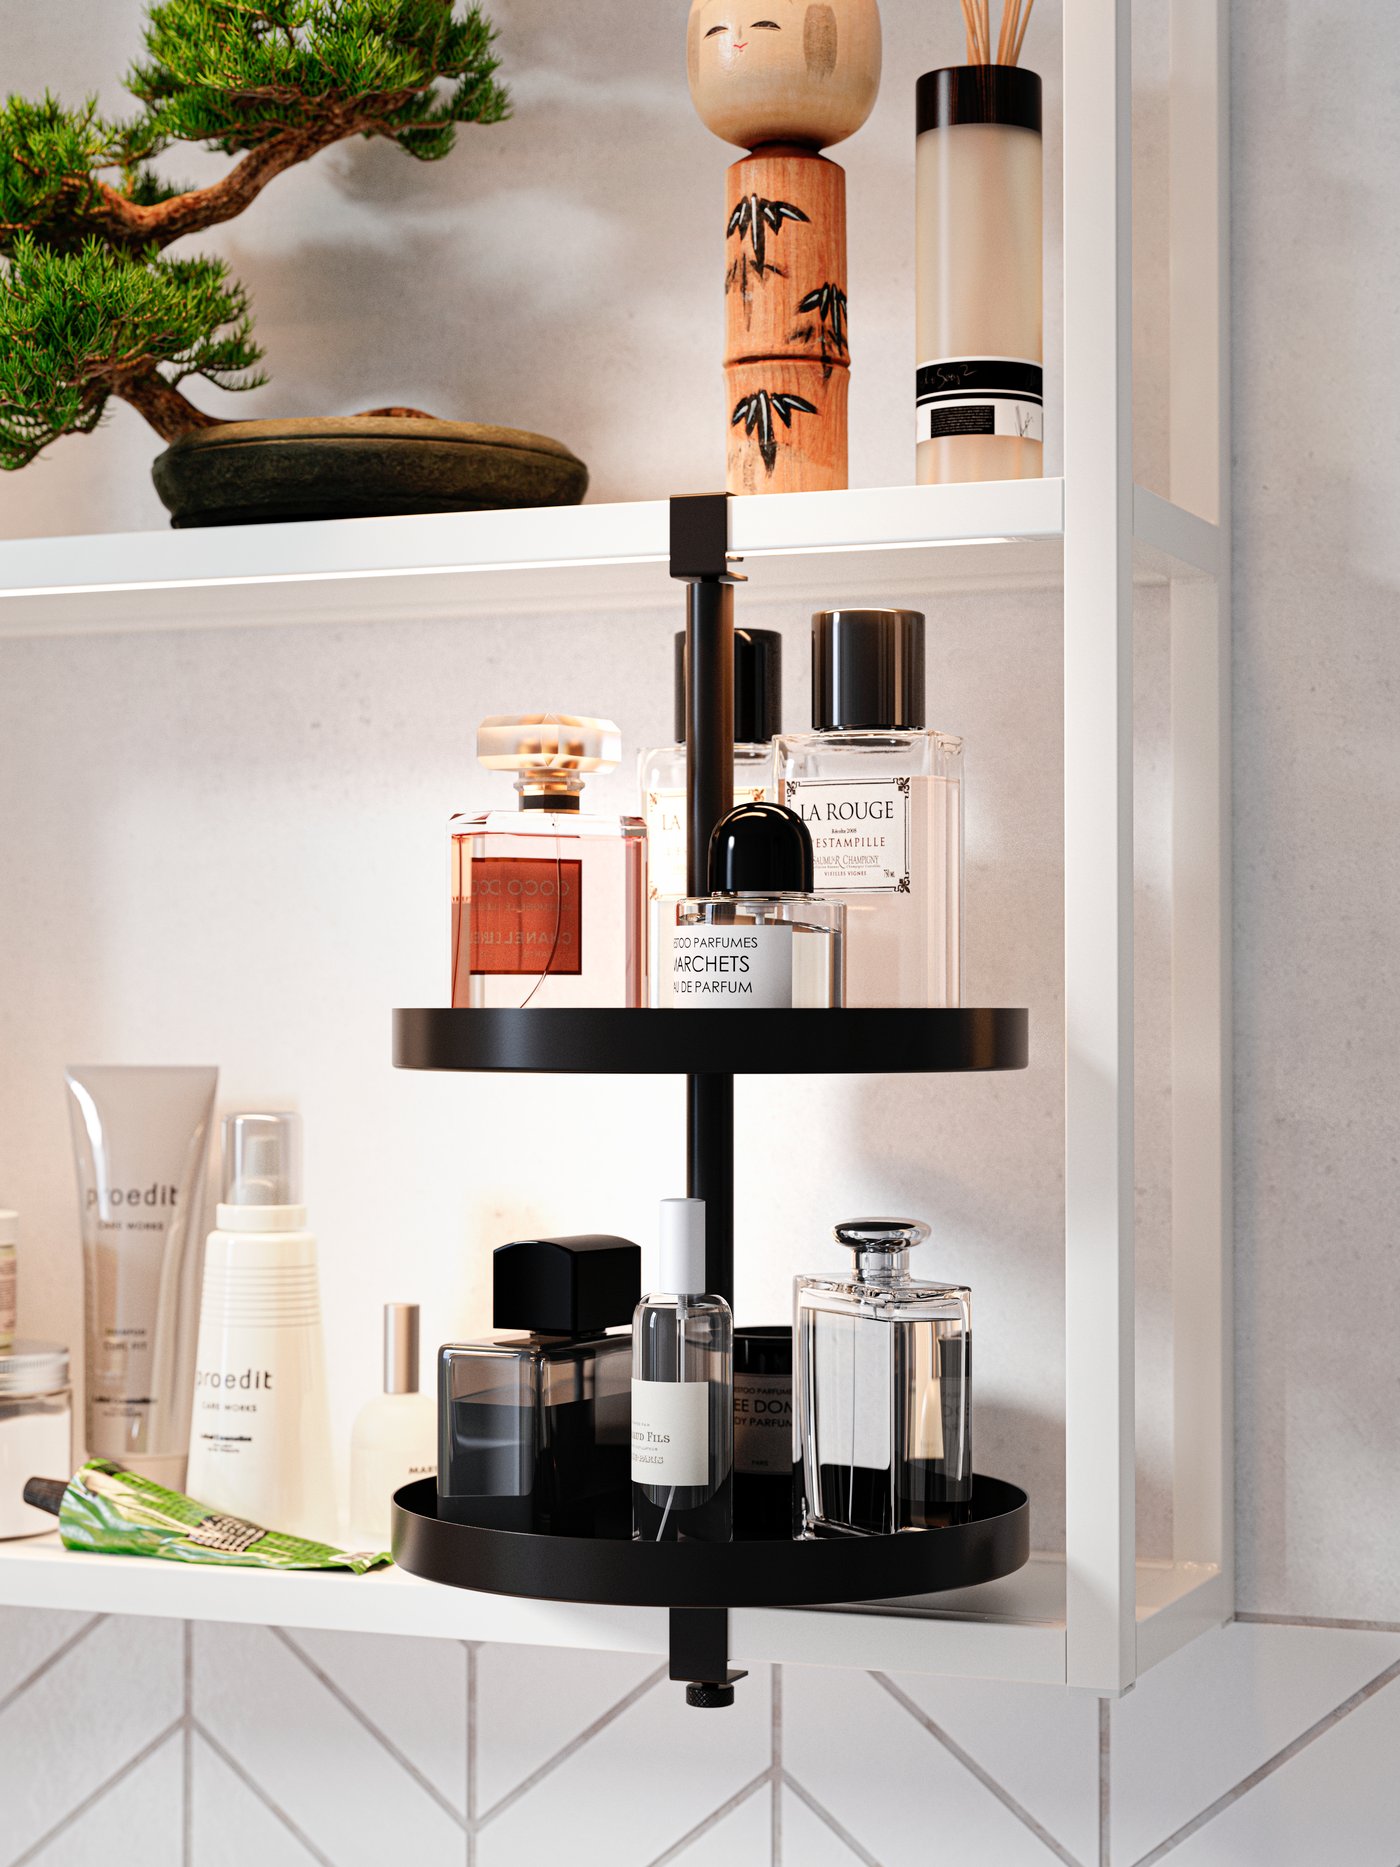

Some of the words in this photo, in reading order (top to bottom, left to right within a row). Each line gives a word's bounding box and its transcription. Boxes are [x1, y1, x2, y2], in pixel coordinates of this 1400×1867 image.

[801, 803, 822, 822] LA
[826, 801, 895, 821] ROUGE
[693, 937, 758, 948] PARFUMES
[681, 981, 692, 993] DE
[694, 981, 753, 994] PARFUM
[86, 1182, 178, 1211] poedit
